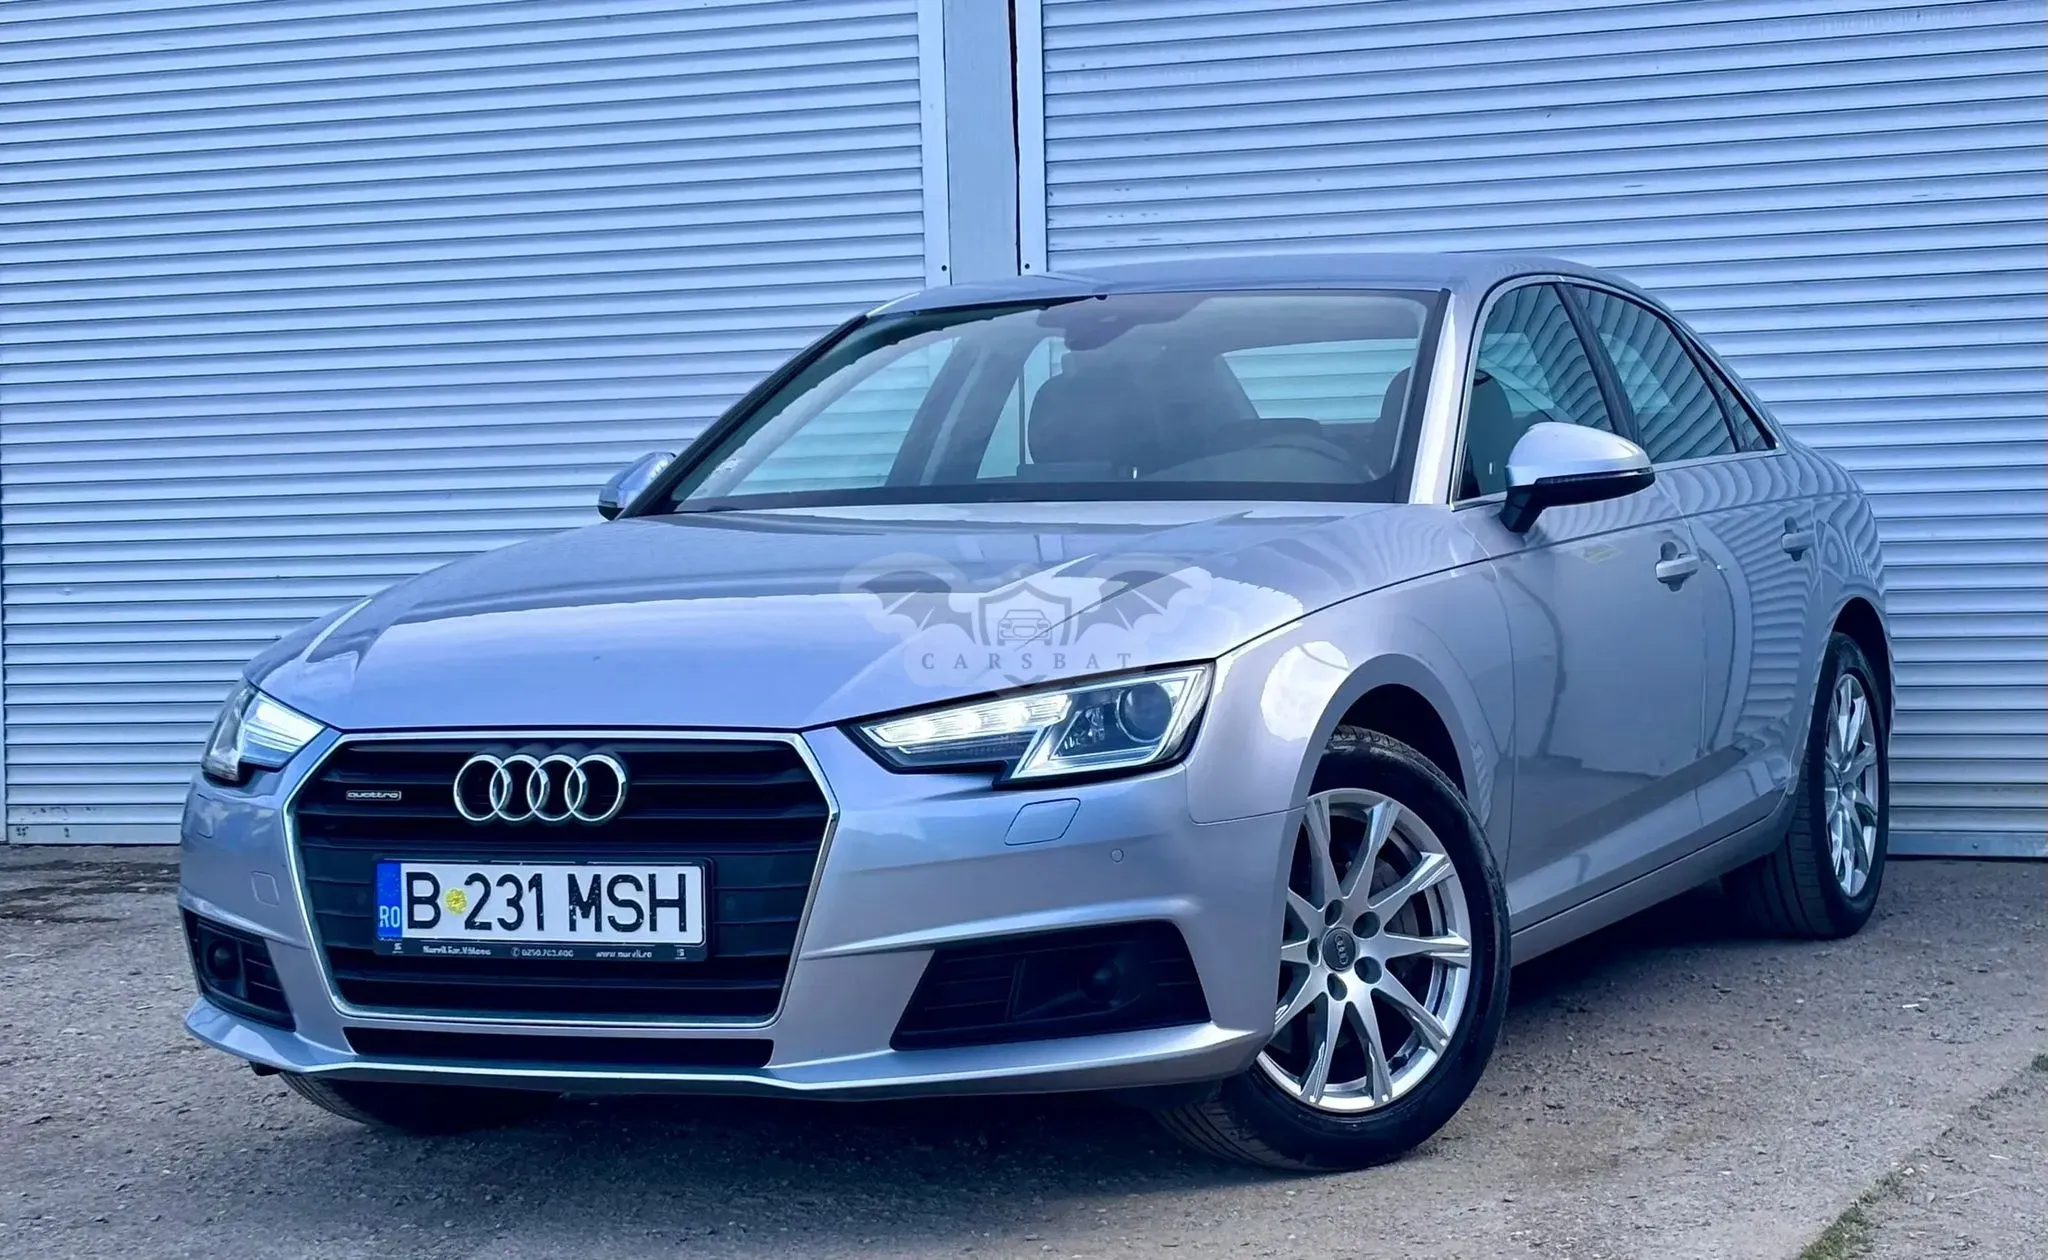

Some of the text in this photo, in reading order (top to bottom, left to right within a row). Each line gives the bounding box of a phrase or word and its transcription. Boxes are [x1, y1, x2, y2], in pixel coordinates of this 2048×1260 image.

[346, 791, 399, 799] quattro
[406, 872, 687, 932] B 231 MSH
[379, 905, 401, 928] RO
